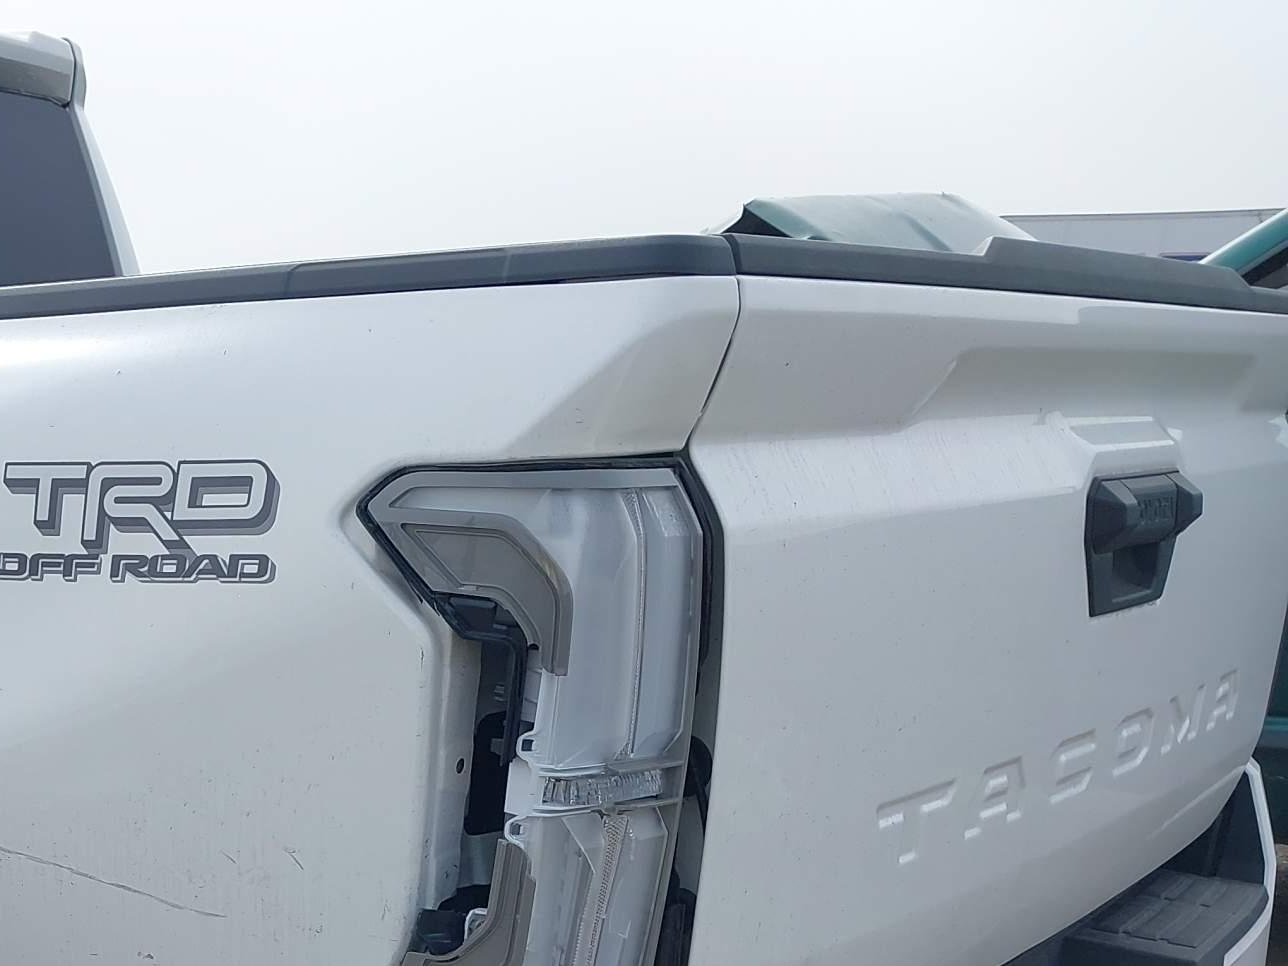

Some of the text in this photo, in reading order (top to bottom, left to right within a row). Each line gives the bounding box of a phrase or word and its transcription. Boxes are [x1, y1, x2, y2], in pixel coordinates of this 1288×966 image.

[3, 459, 280, 556] TRD
[109, 553, 277, 584] ROAD
[876, 669, 1239, 865] TACOMA
